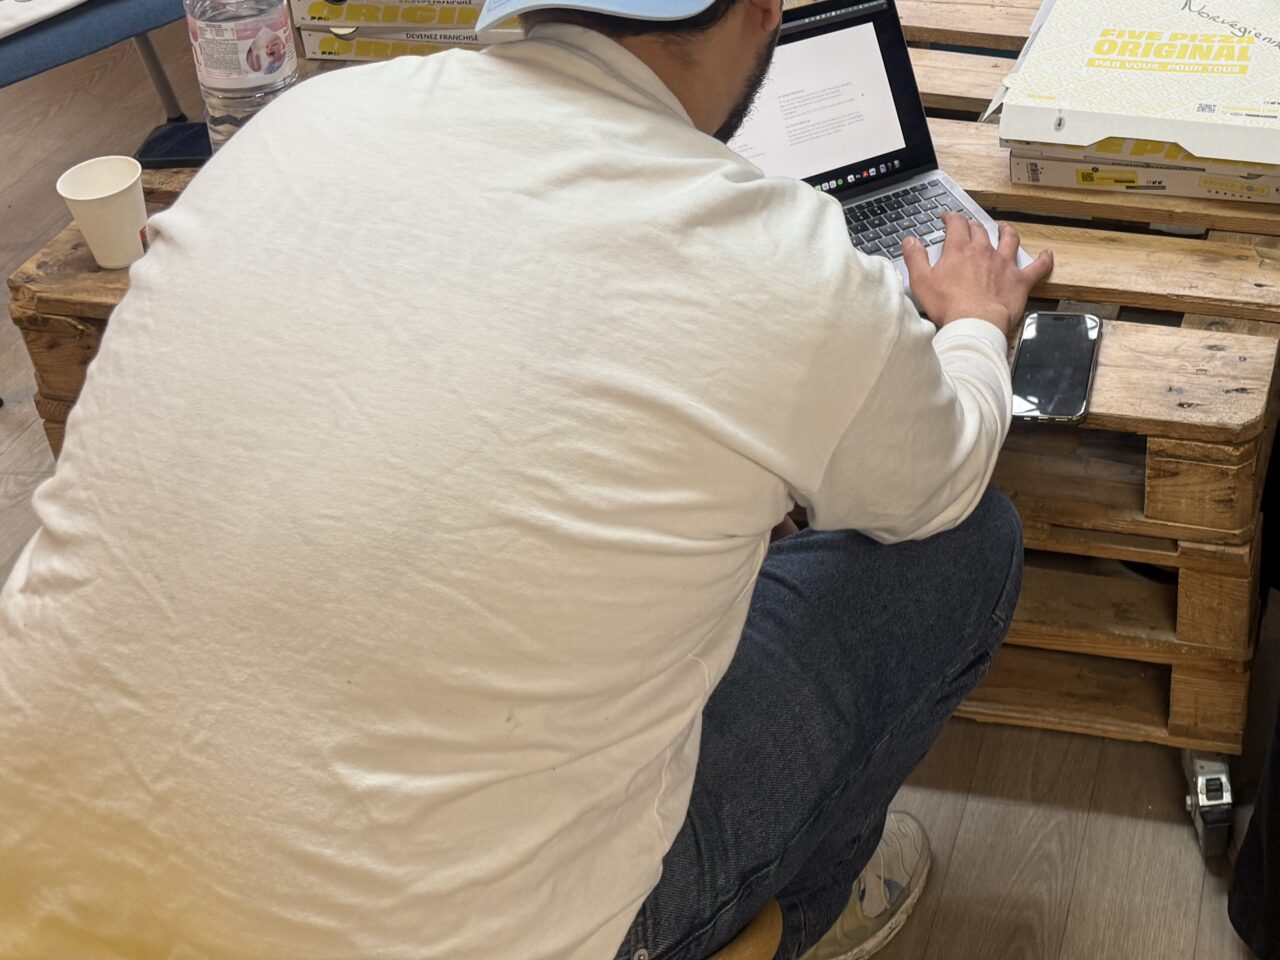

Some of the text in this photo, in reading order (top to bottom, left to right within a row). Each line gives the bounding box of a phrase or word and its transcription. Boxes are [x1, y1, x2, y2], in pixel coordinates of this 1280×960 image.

[405, 32, 438, 42] DEVENEZ
[1099, 27, 1256, 45] FIVE PIZZA
[1092, 39, 1253, 63] ORIGINAL
[1094, 59, 1122, 69] PAR
[1168, 64, 1204, 72] POUR
[1208, 65, 1241, 74] TOUS
